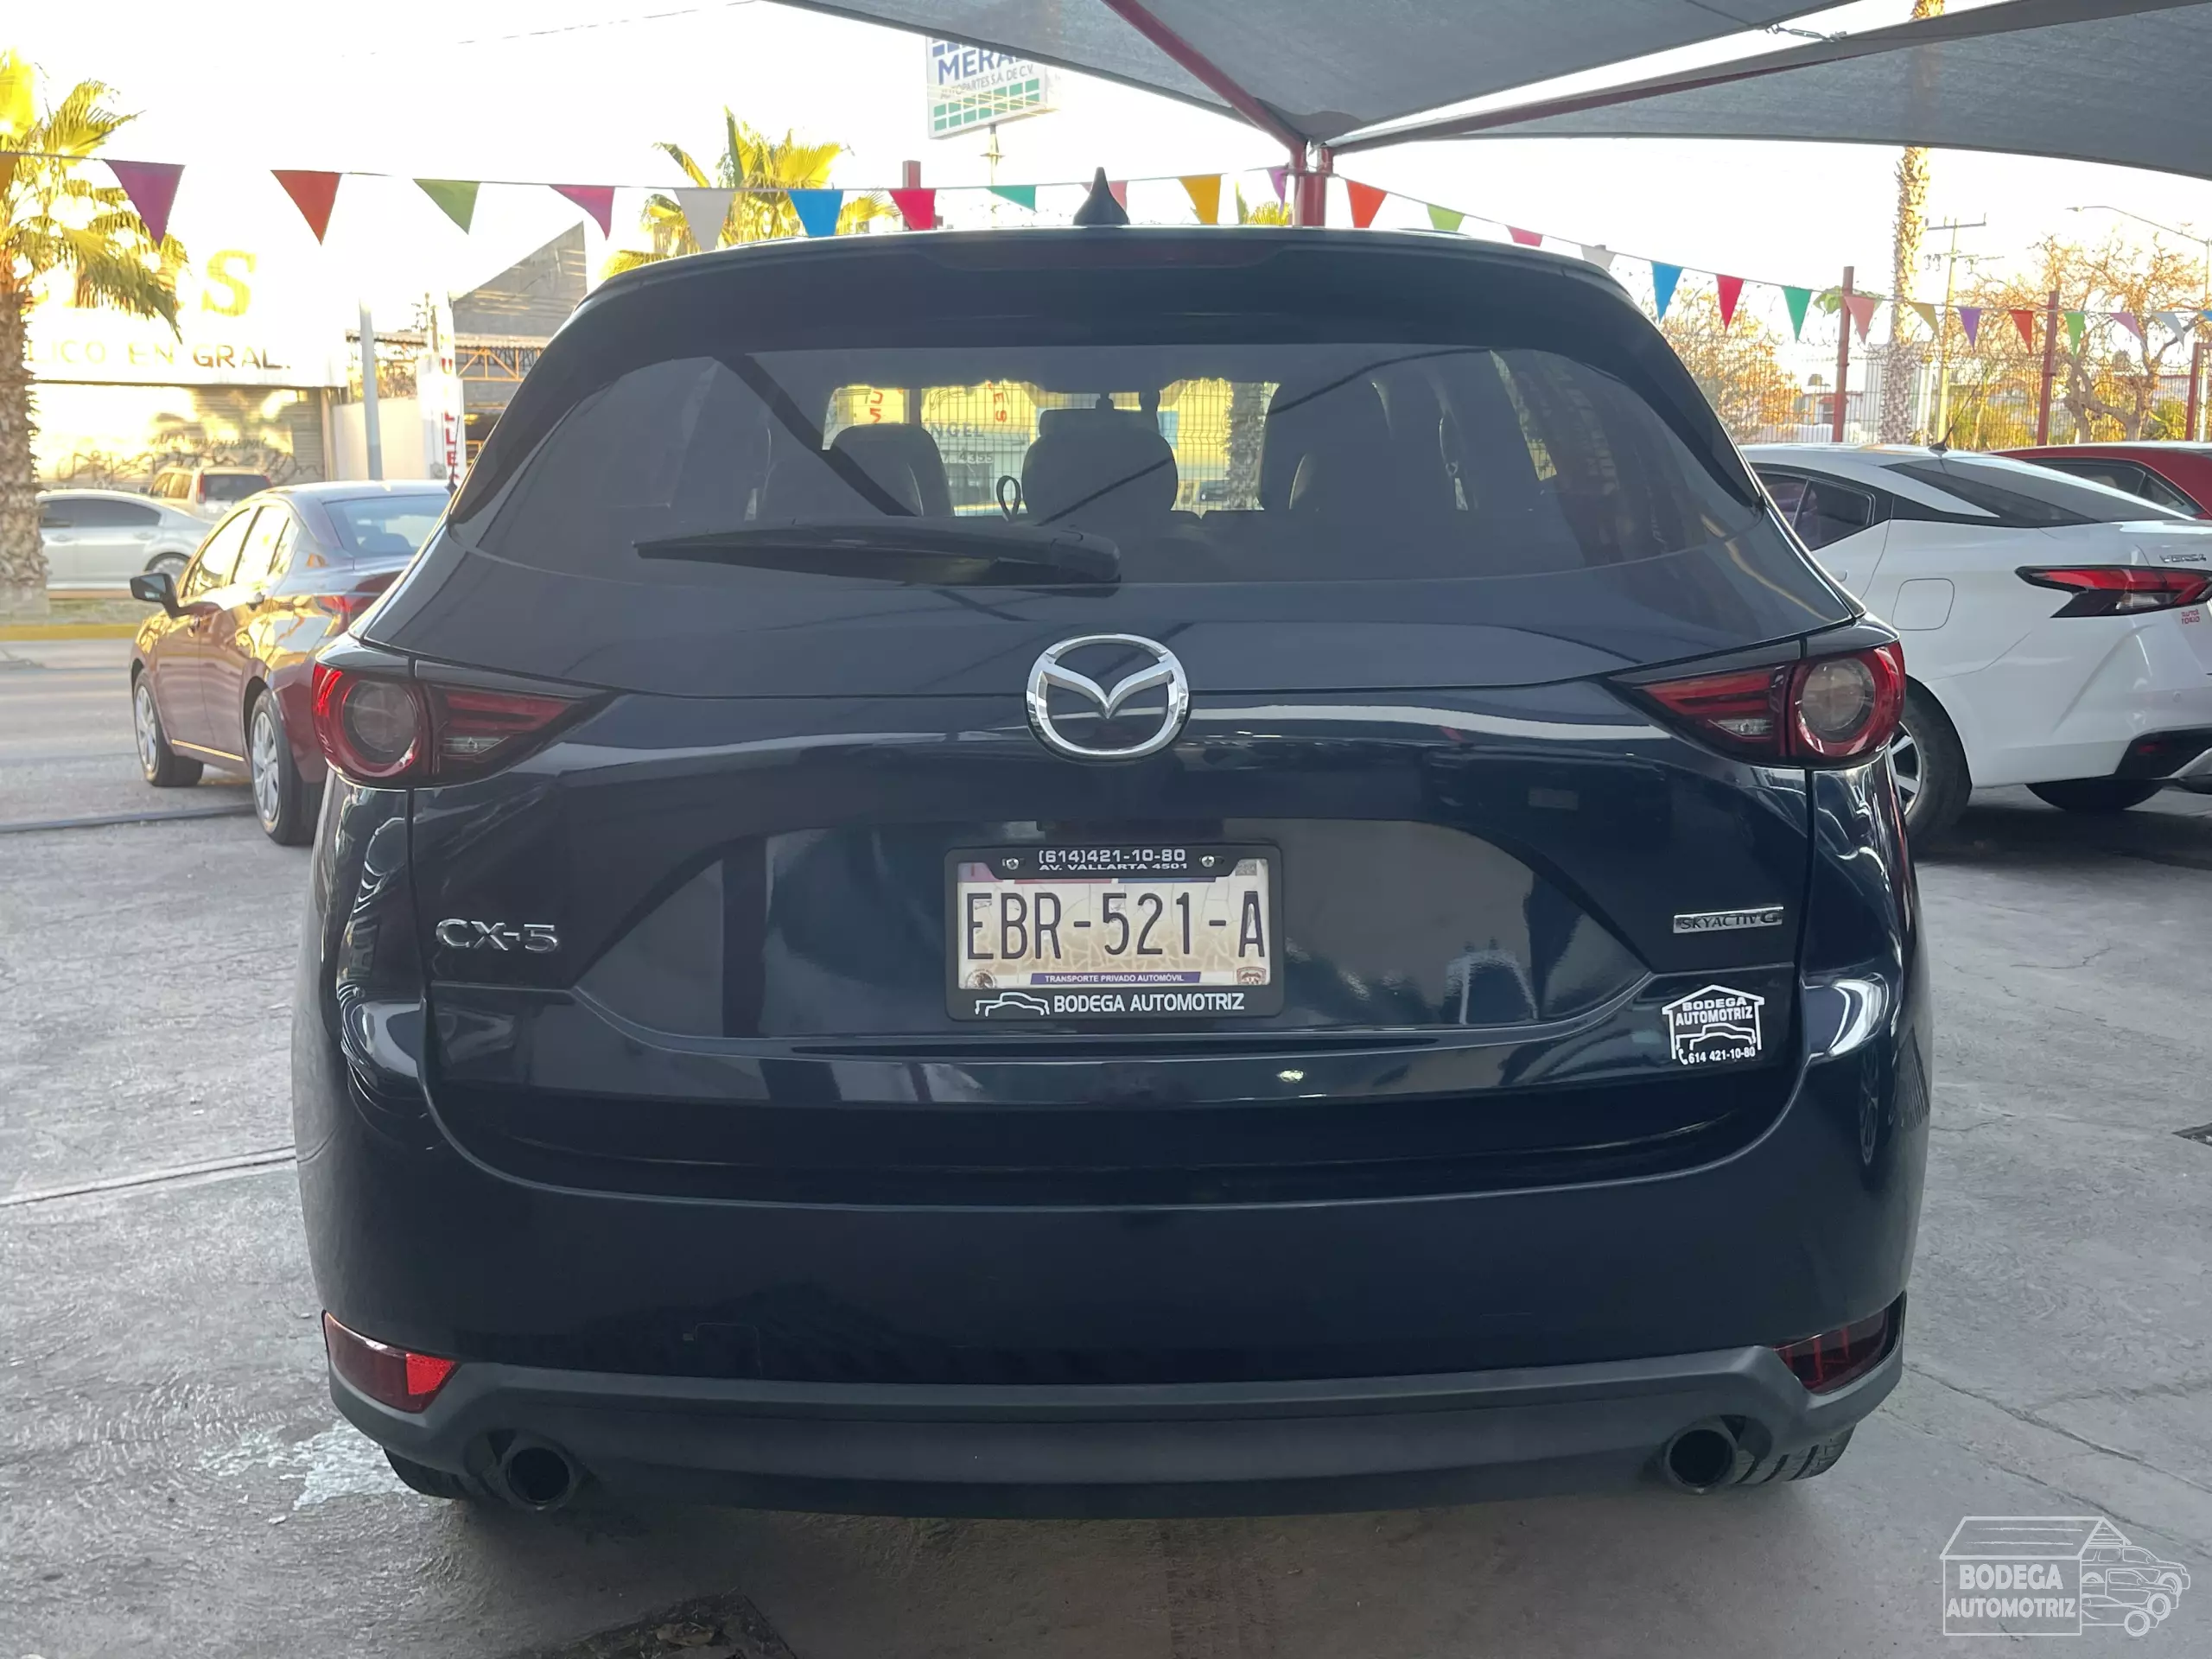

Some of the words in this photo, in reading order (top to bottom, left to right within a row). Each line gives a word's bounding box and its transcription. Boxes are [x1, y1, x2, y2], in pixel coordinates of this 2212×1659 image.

[938, 48, 1025, 86] MERA
[1006, 66, 1017, 80] DE
[193, 344, 291, 369] GRAL.
[1039, 849, 1185, 864] (614)421-10-80
[435, 918, 559, 953] CX-5
[966, 891, 1265, 959] EBR-521-A
[1045, 975, 1098, 983] TRANSPORTE
[1101, 974, 1136, 983] PRIVADO
[1053, 995, 1126, 1013] BODEGA
[1129, 992, 1245, 1012] AUTOMOTRIZ
[1681, 996, 1747, 1012] BODEGA
[1675, 1006, 1753, 1027] AUTOMOTRIZ
[1688, 1051, 1707, 1064] 614
[1709, 1046, 1756, 1061] 421-10-80
